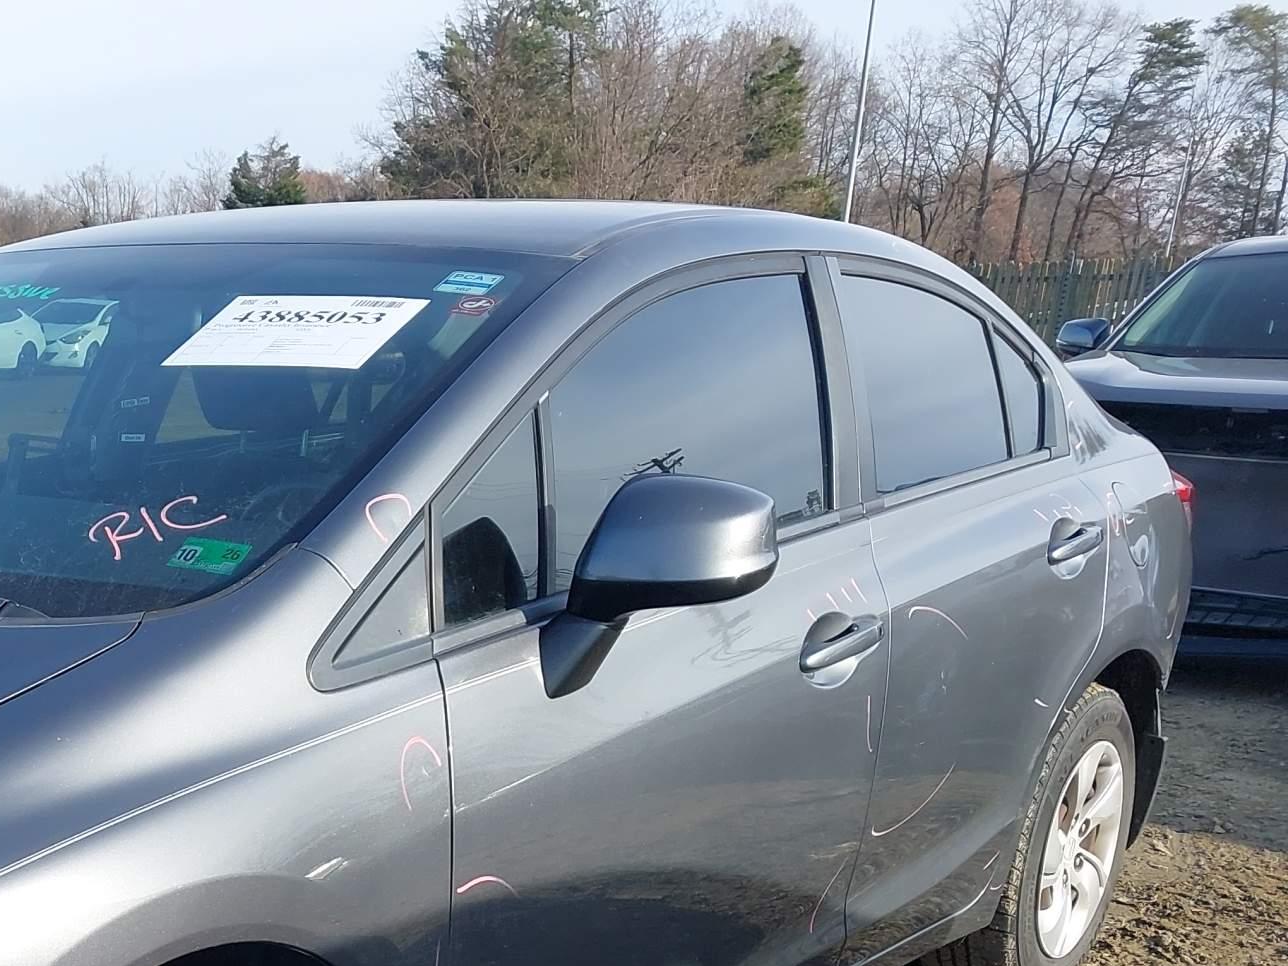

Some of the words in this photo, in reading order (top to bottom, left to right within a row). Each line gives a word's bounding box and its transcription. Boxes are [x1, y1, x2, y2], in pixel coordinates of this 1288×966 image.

[452, 273, 484, 281] PCA
[231, 310, 387, 325] 43885053
[176, 548, 199, 562] 10
[221, 549, 241, 561] 26
